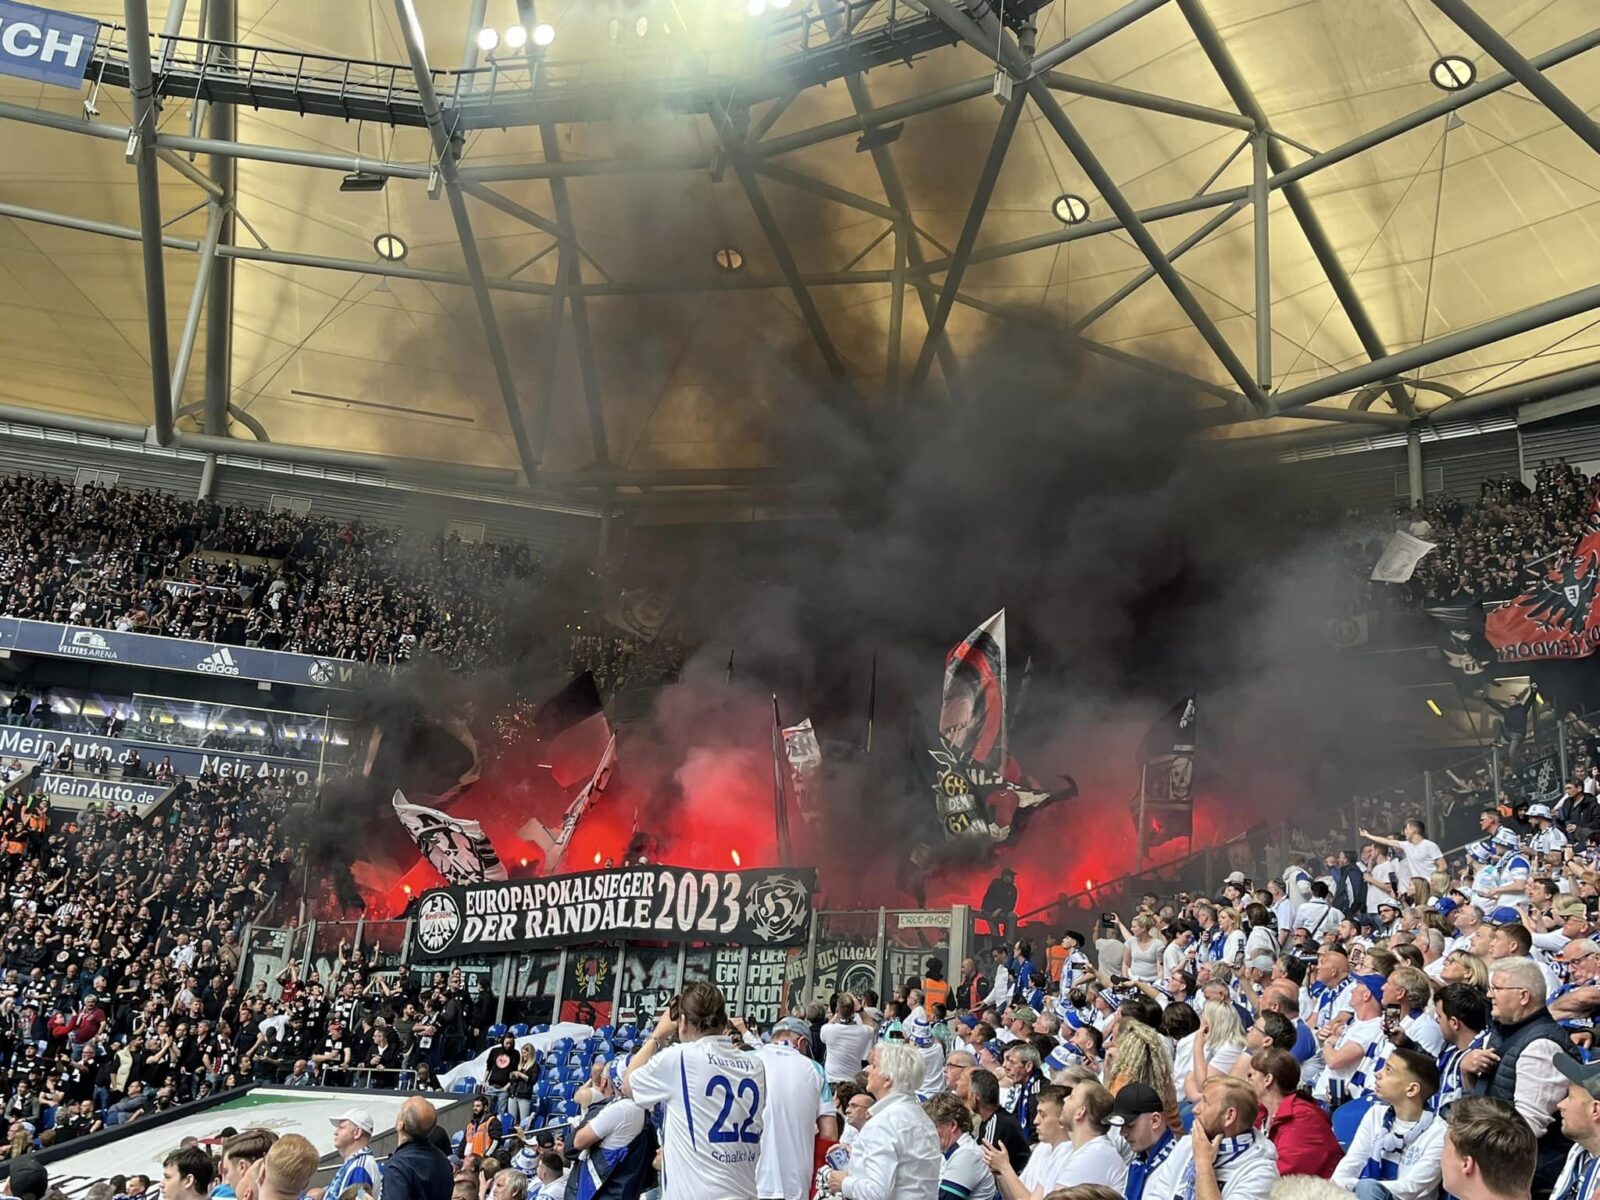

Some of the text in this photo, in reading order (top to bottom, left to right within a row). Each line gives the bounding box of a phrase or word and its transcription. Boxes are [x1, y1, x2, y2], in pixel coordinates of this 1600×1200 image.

[0, 18, 84, 68] CH
[89, 648, 118, 660] ARENA
[197, 661, 239, 676] adidas
[42, 776, 155, 805] MeinAuto.de
[465, 872, 655, 915] EUROPAPOKALSIEGER
[654, 871, 742, 934] 2023
[461, 899, 652, 943] DER RANDALE
[715, 963, 786, 985] GRPPE
[707, 1053, 754, 1071] Kuranyi
[705, 1074, 760, 1144] 22
